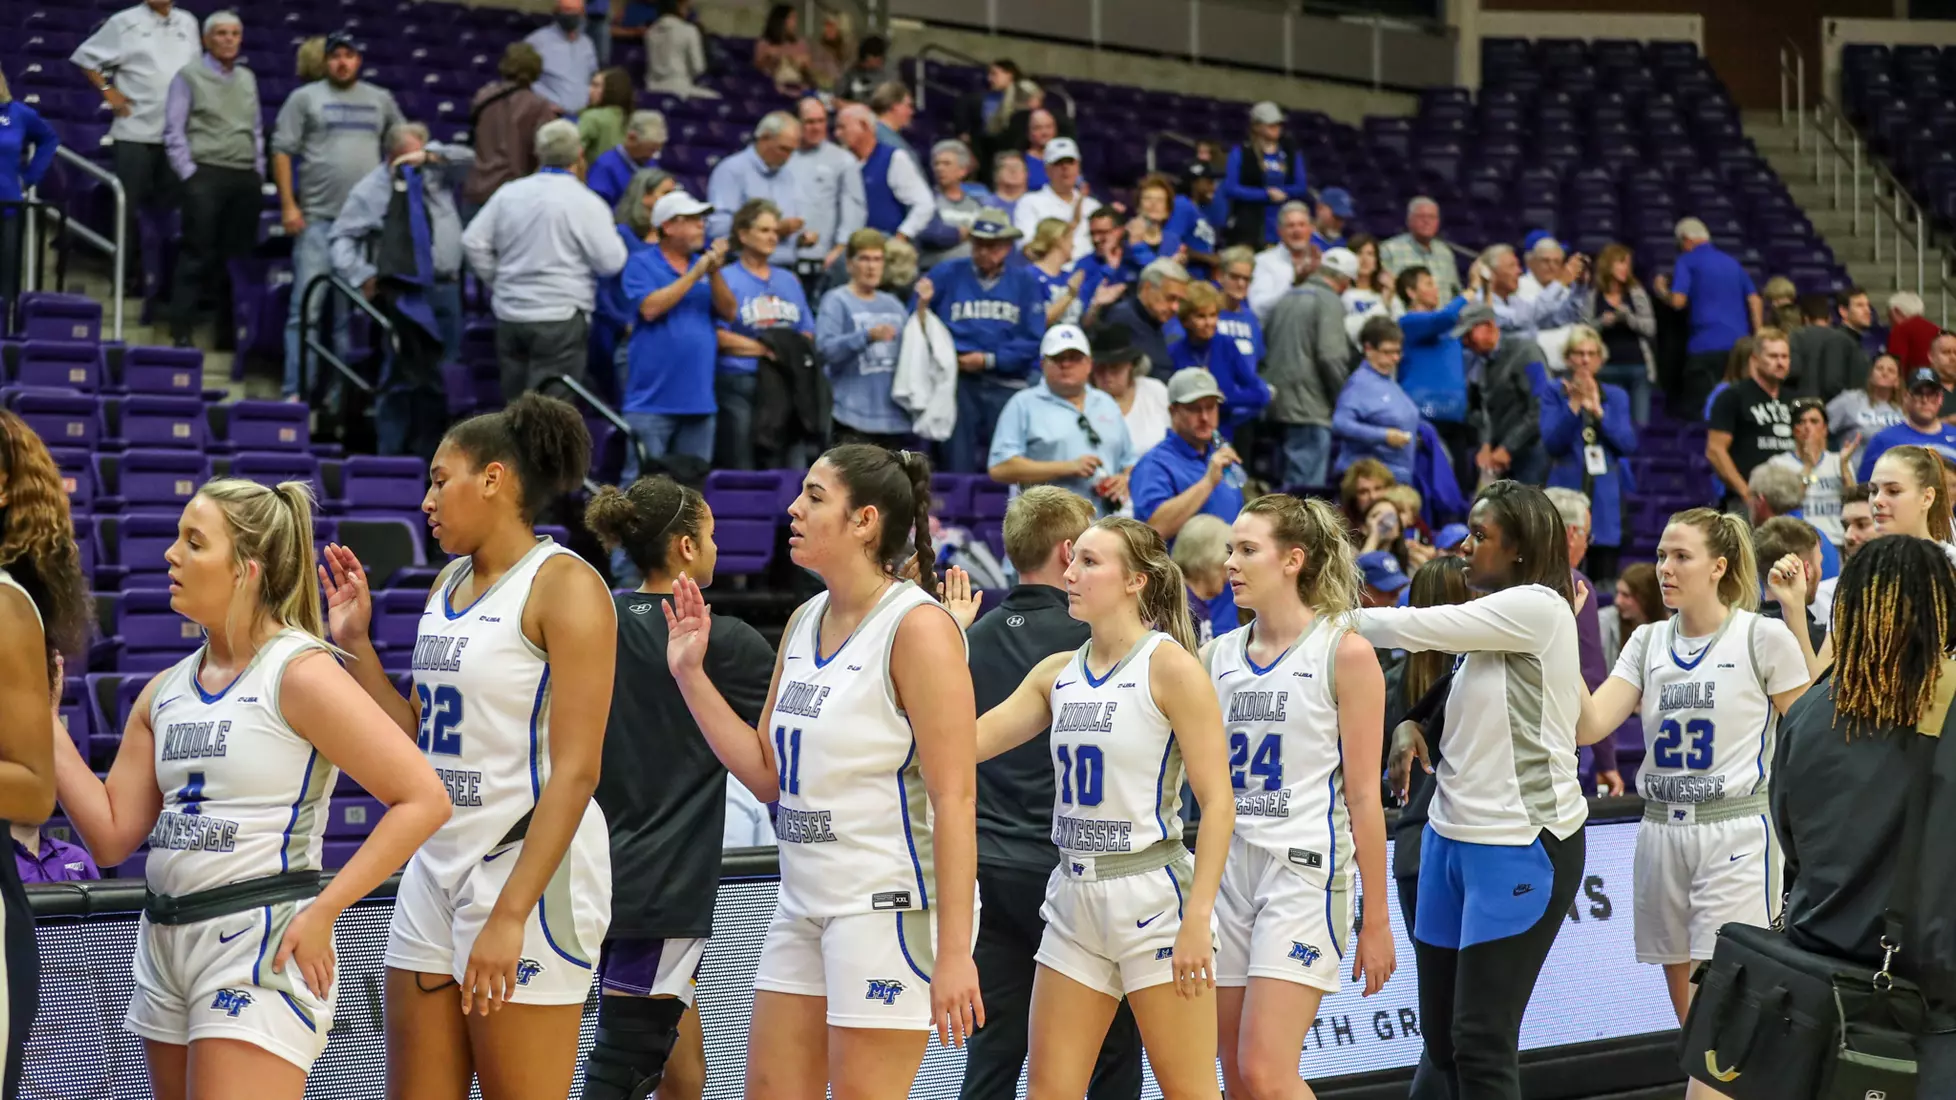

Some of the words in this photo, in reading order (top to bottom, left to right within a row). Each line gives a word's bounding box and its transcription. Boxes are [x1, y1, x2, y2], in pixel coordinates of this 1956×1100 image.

[950, 300, 1020, 324] RAIDERS
[776, 680, 831, 719] MIDDLE
[1228, 691, 1288, 722] MIDDLE
[1659, 682, 1715, 710] MIDDLE
[417, 684, 464, 756] 22
[1055, 702, 1117, 733] MIDDLE
[162, 720, 232, 761] MIDDLE
[1654, 719, 1716, 770] 23
[775, 725, 803, 795] 11
[1057, 744, 1105, 806] 10
[1230, 732, 1284, 791] 24
[1644, 773, 1726, 804] TENNESSEE
[211, 988, 251, 1017] MT
[866, 980, 904, 1005] MT
